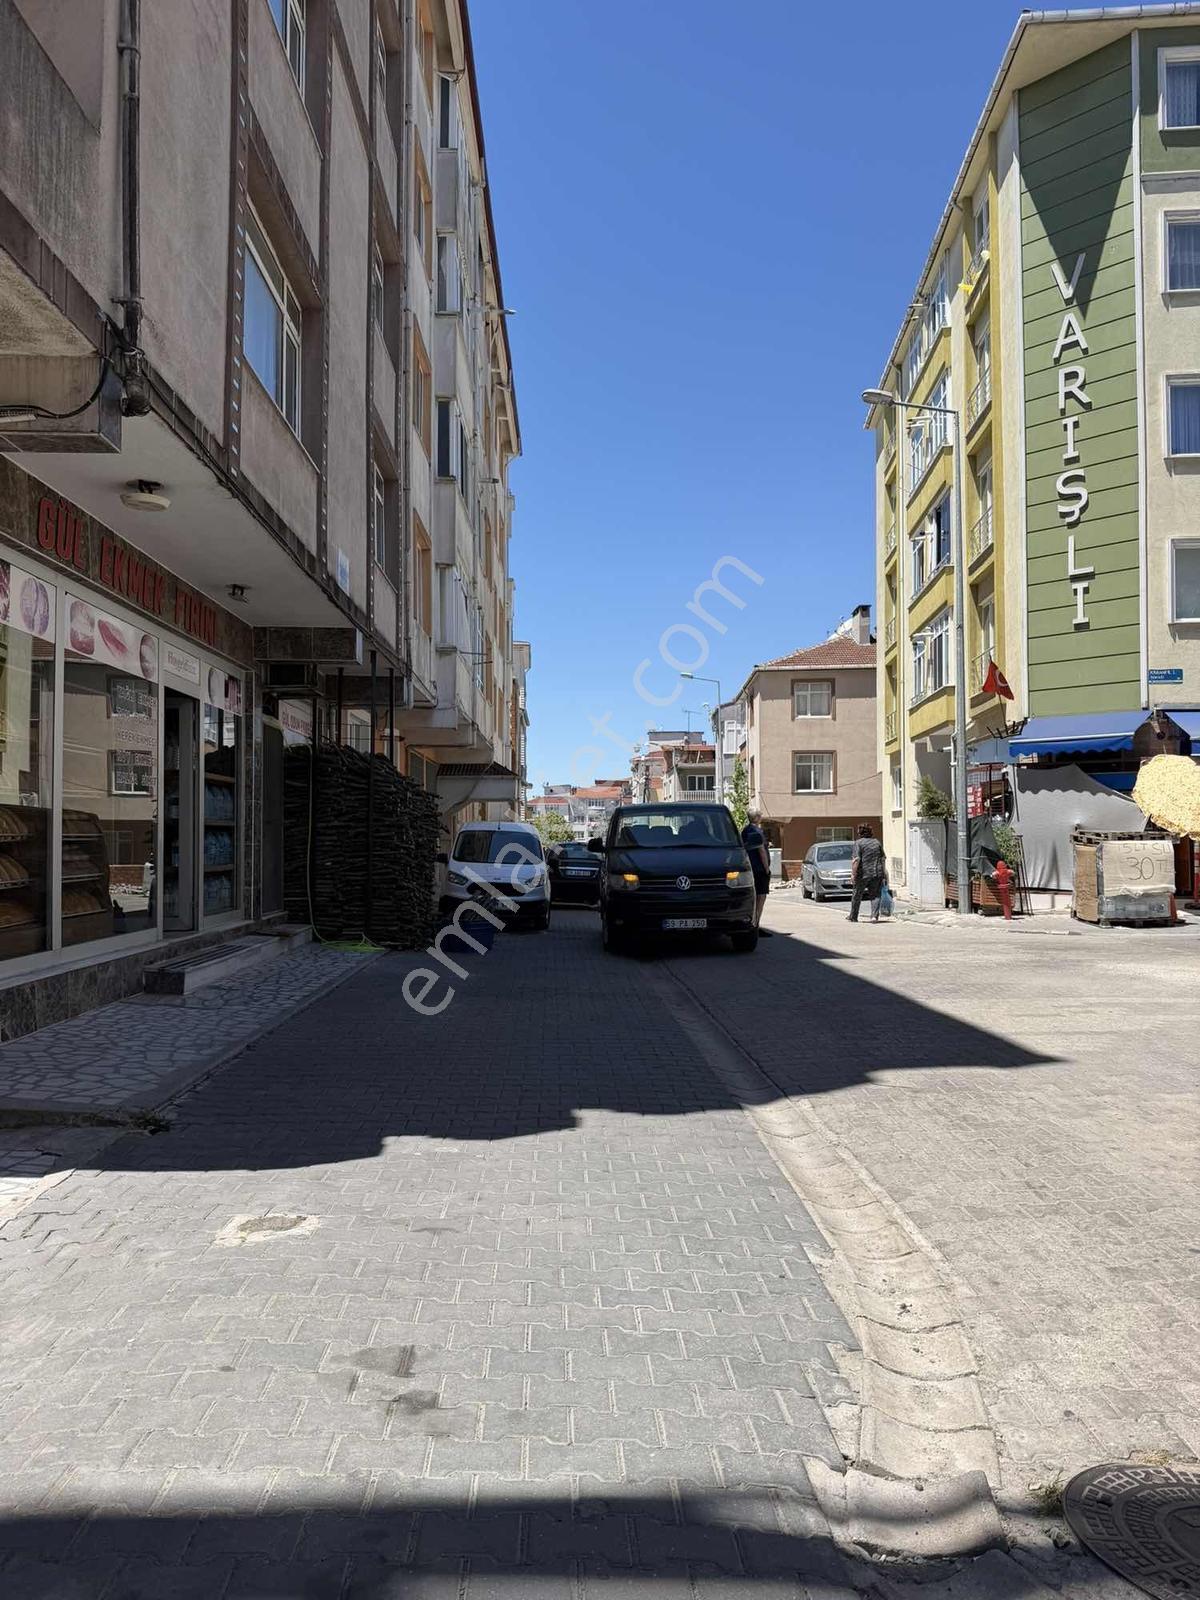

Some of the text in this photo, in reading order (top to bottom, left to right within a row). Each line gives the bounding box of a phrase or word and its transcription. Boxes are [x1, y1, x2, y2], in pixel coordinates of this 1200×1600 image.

[1050, 252, 1095, 627] VARIŞLI
[38, 497, 86, 571] GÜL
[100, 536, 165, 615] EKMEK
[1126, 856, 1154, 880] 30
